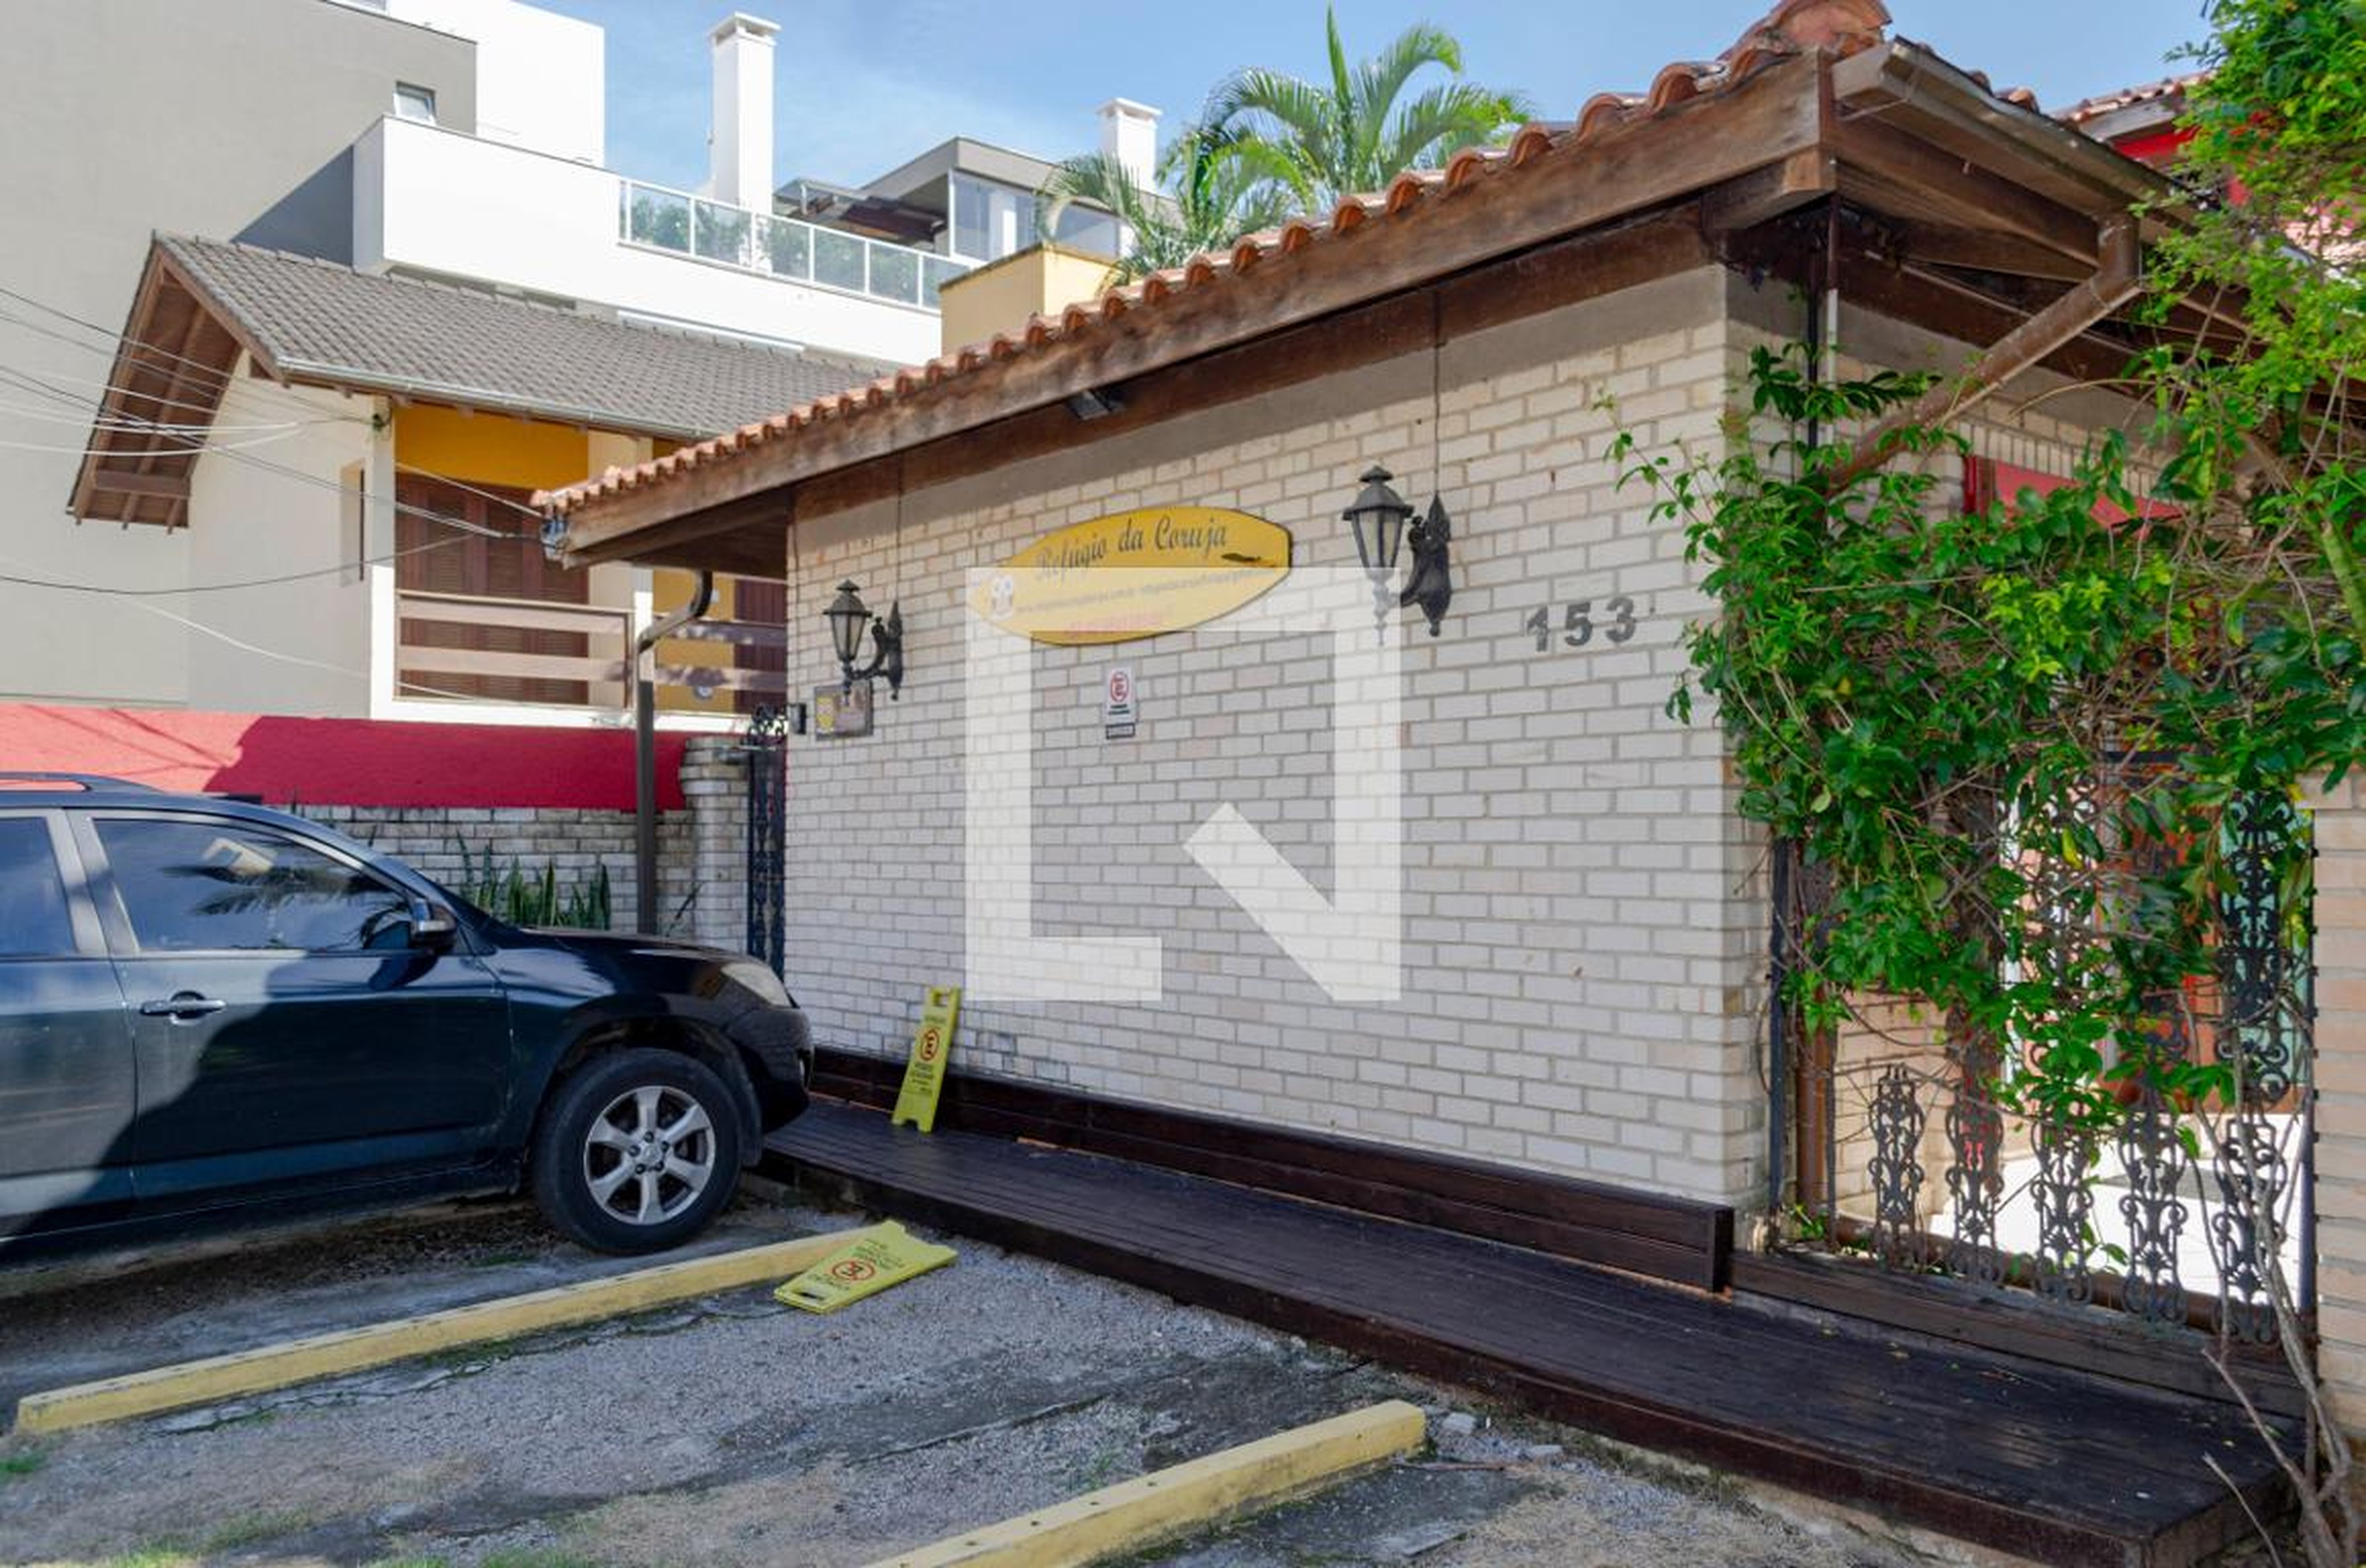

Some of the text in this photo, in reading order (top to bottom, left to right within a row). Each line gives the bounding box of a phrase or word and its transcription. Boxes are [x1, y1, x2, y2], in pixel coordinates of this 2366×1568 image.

[1118, 518, 1143, 553] da
[1154, 515, 1226, 561] Coruja
[1526, 596, 1636, 652] 153
